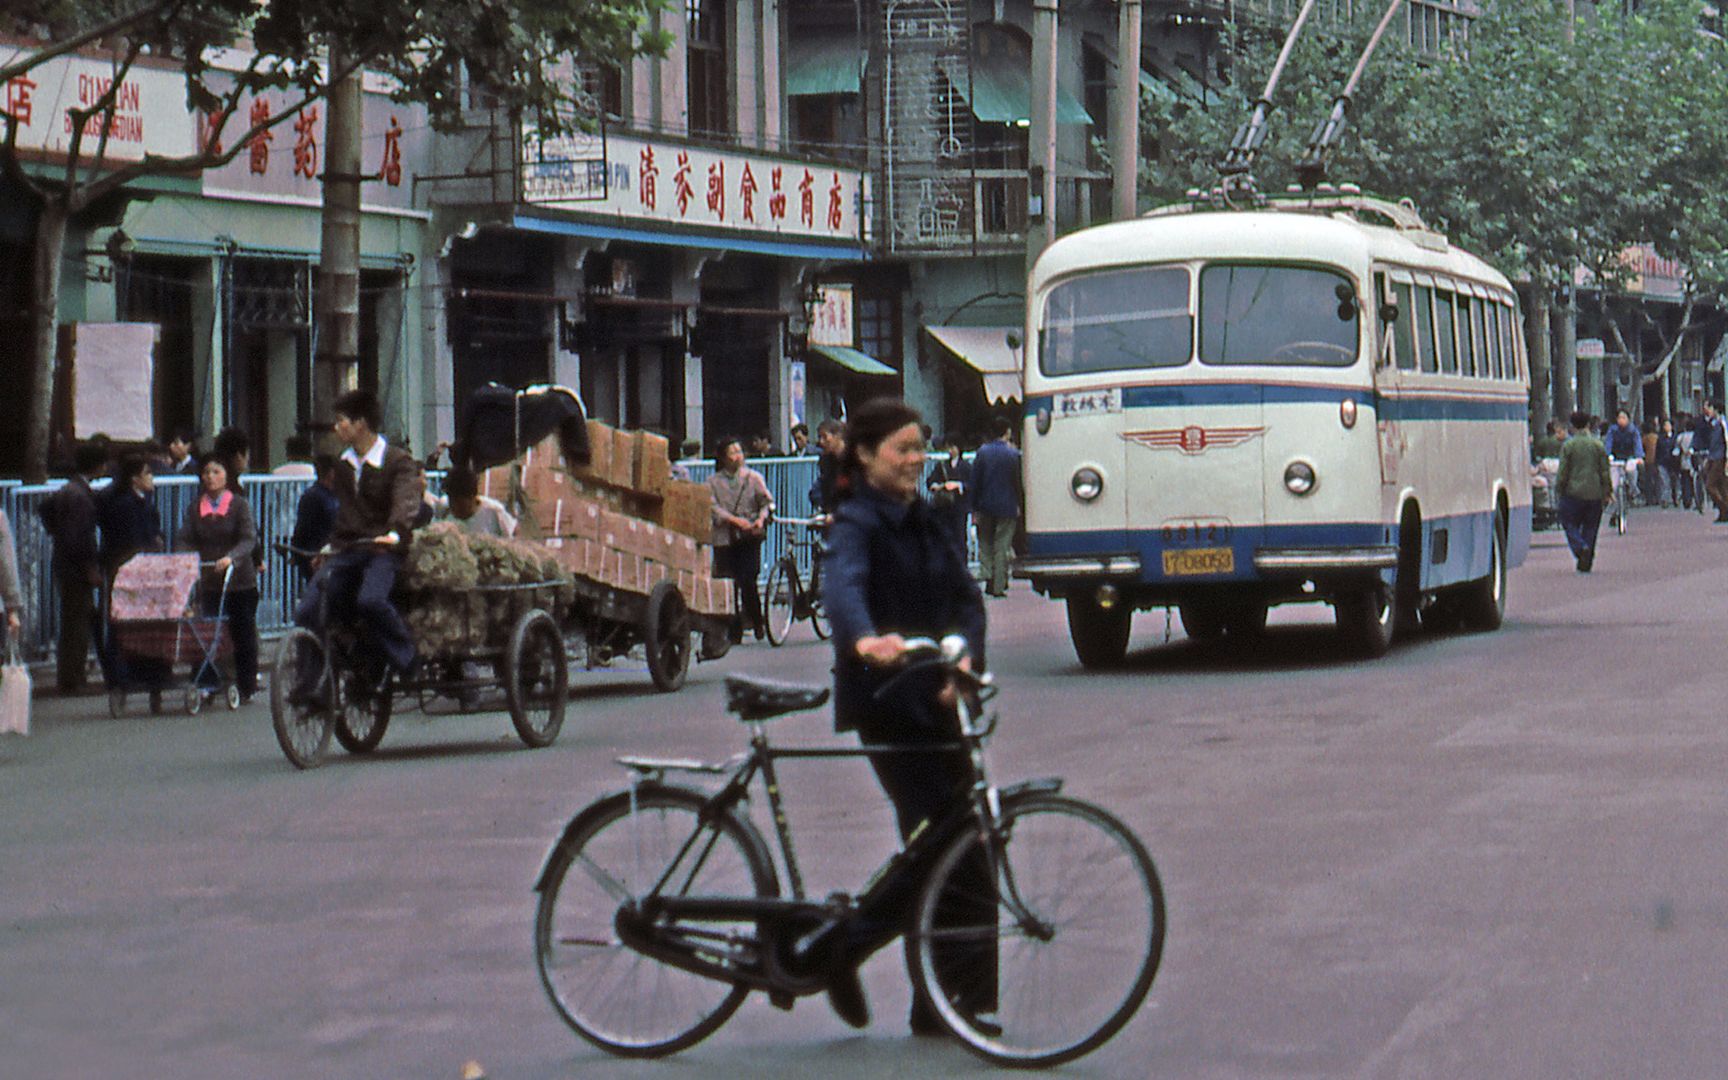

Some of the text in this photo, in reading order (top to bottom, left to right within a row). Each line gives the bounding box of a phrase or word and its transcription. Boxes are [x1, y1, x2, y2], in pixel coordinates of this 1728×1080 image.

[639, 144, 843, 230] 清芬副食品商店
